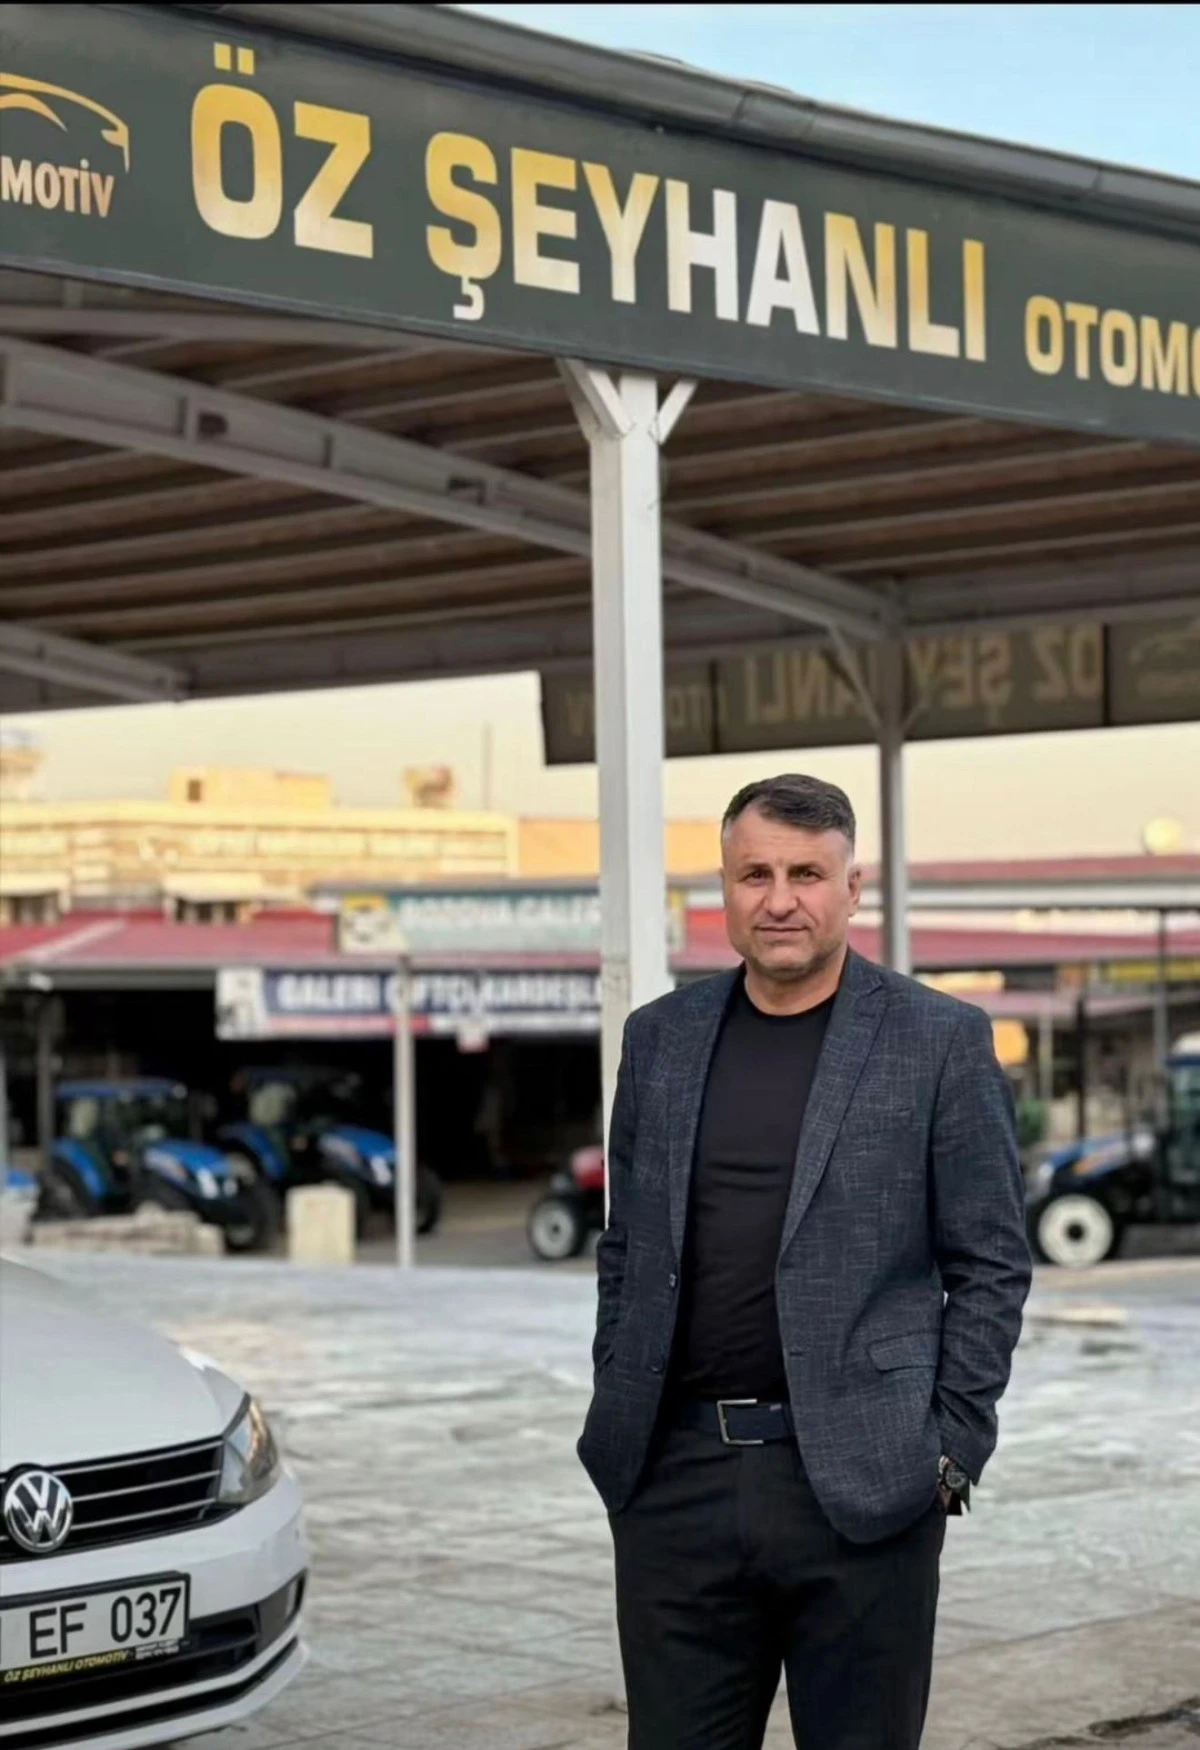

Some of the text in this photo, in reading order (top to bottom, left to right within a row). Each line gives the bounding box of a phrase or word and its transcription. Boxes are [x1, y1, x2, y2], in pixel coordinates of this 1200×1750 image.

[191, 42, 1200, 399] ÖZ ŞEYHANLI OTOM
[29, 1587, 181, 1659] EF 037
